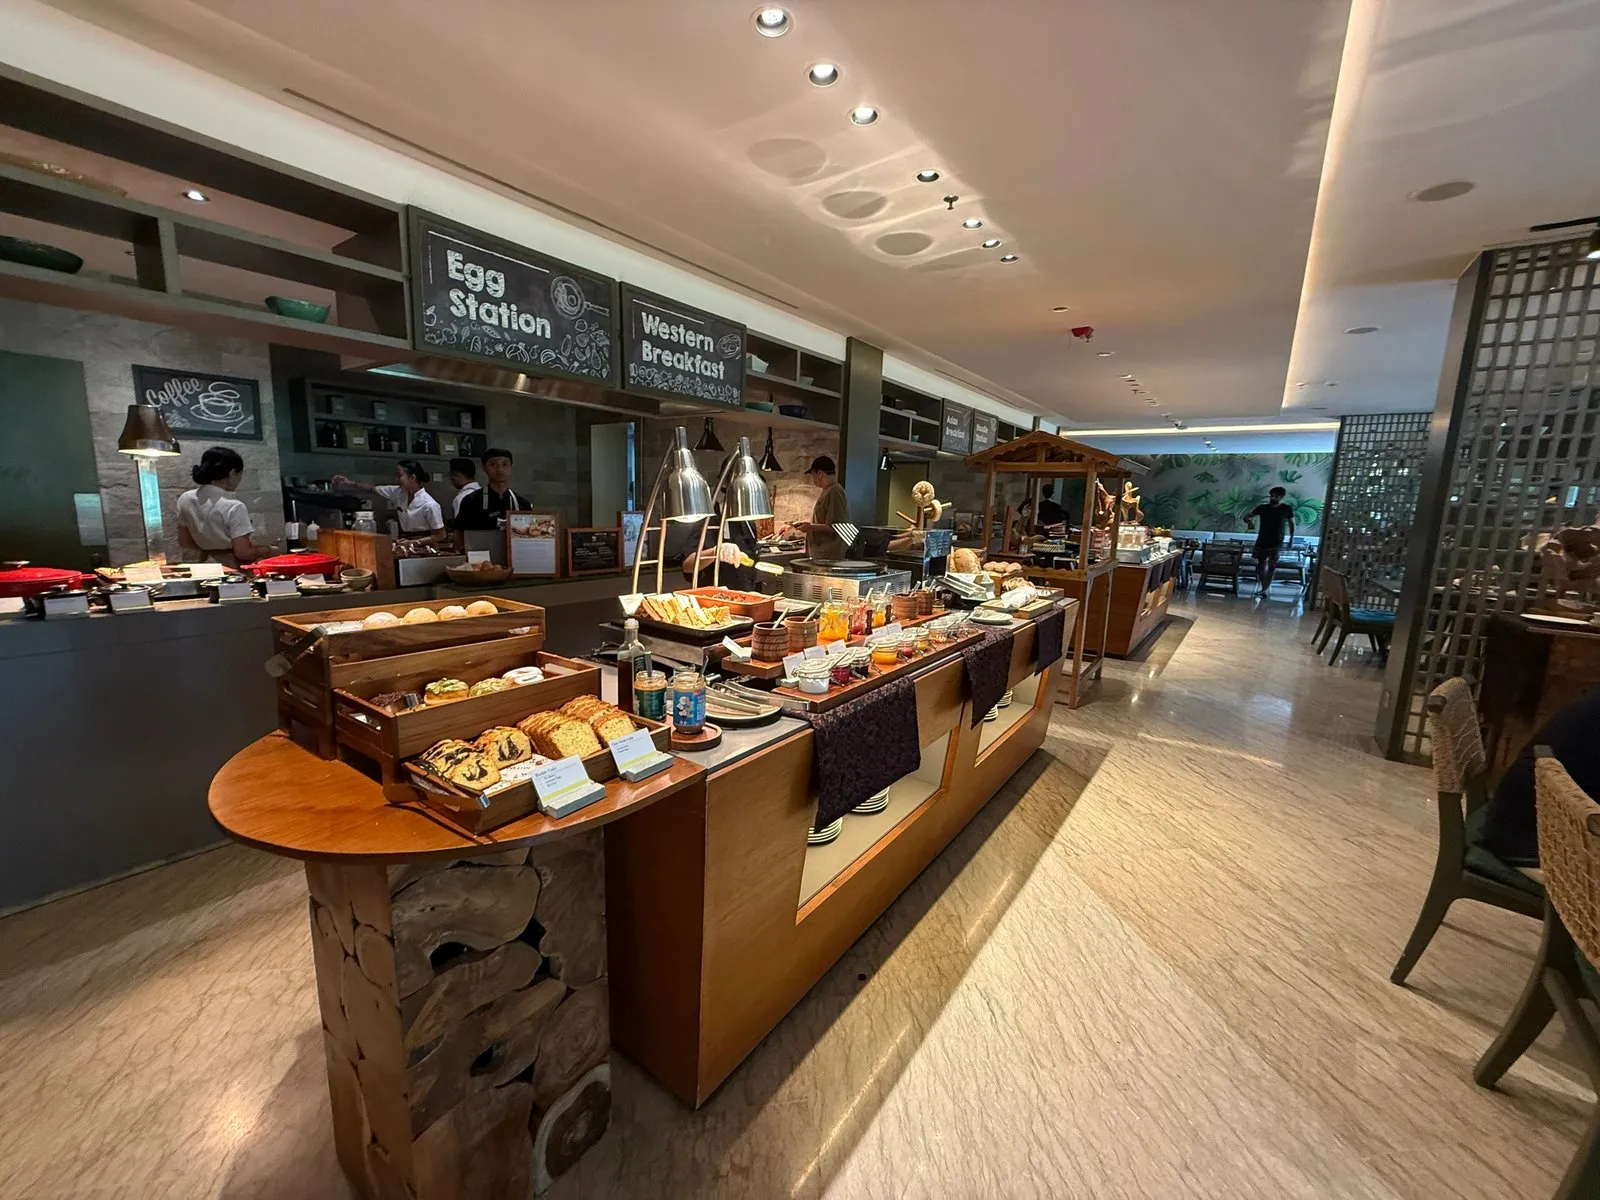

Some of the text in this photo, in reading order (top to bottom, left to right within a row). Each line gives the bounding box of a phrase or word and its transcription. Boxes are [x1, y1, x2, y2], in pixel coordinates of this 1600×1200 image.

[446, 249, 505, 298] Egg
[448, 288, 552, 339] Station
[641, 311, 714, 353] Western
[641, 339, 725, 381] Breakfast
[145, 377, 204, 408] Coffee
[945, 426, 965, 439] Breakfast
